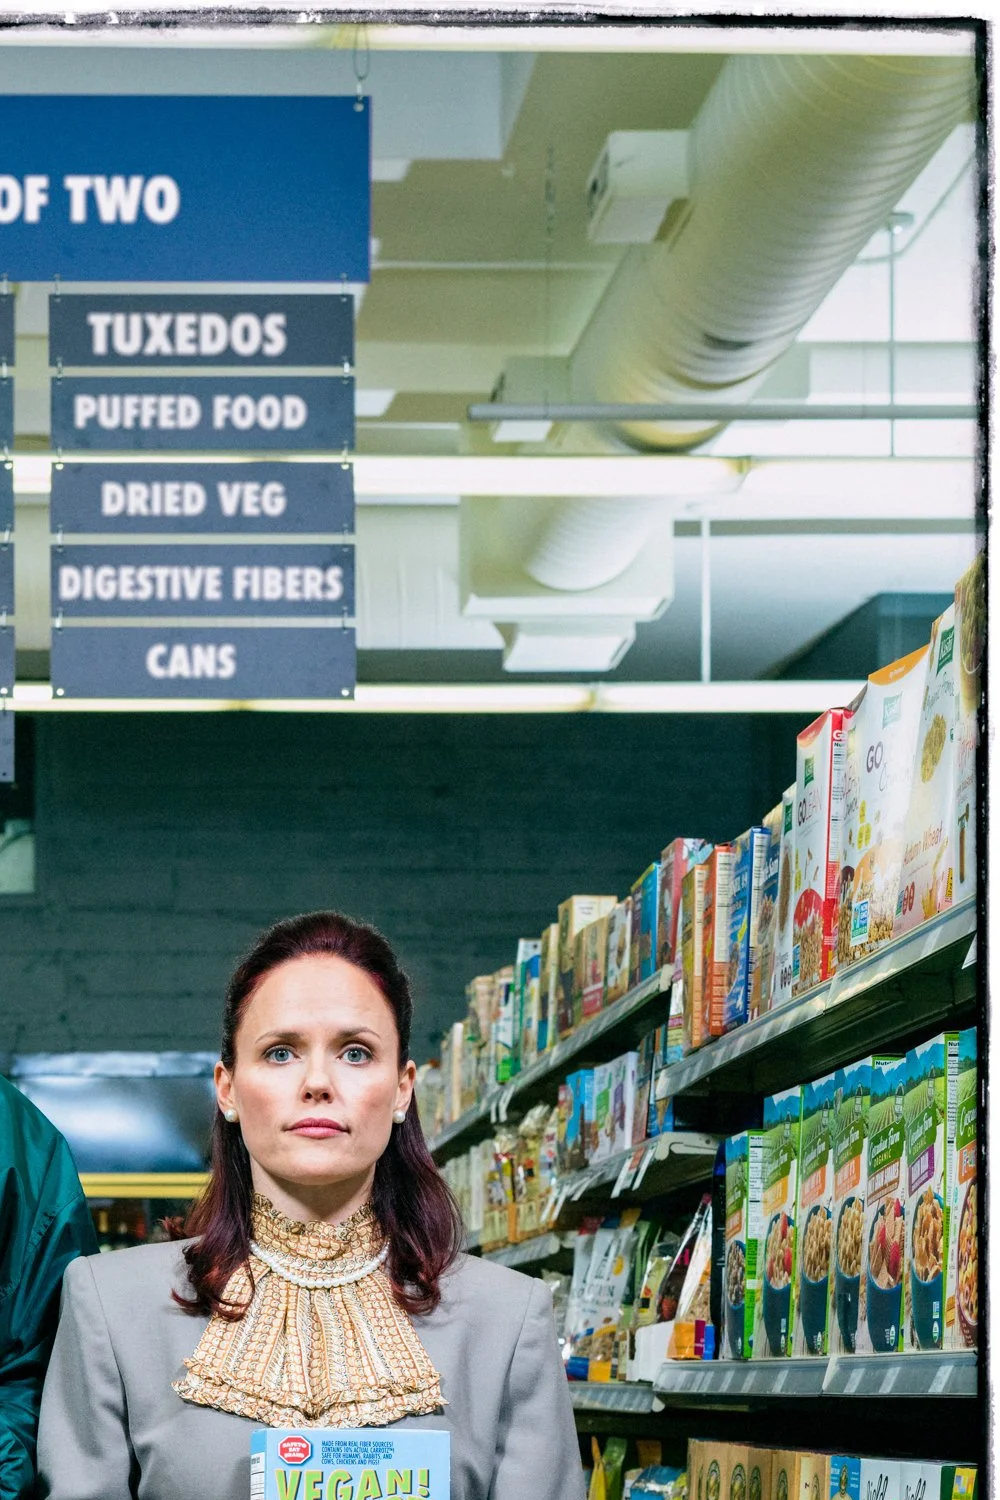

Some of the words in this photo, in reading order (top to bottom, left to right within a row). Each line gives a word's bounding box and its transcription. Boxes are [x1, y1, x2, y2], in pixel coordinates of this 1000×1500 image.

[63, 174, 180, 224] TWO
[88, 312, 287, 356] TUXEDOS
[74, 394, 200, 430] PUFFED
[212, 394, 306, 430] FOOD
[101, 481, 206, 517] DRIED
[218, 481, 287, 517] VEG
[59, 565, 222, 601] DIGESTIVE
[232, 565, 343, 601] FIBERS
[146, 643, 236, 680] CANS
[866, 741, 883, 773] GO
[873, 1153, 892, 1168] ORGANIC
